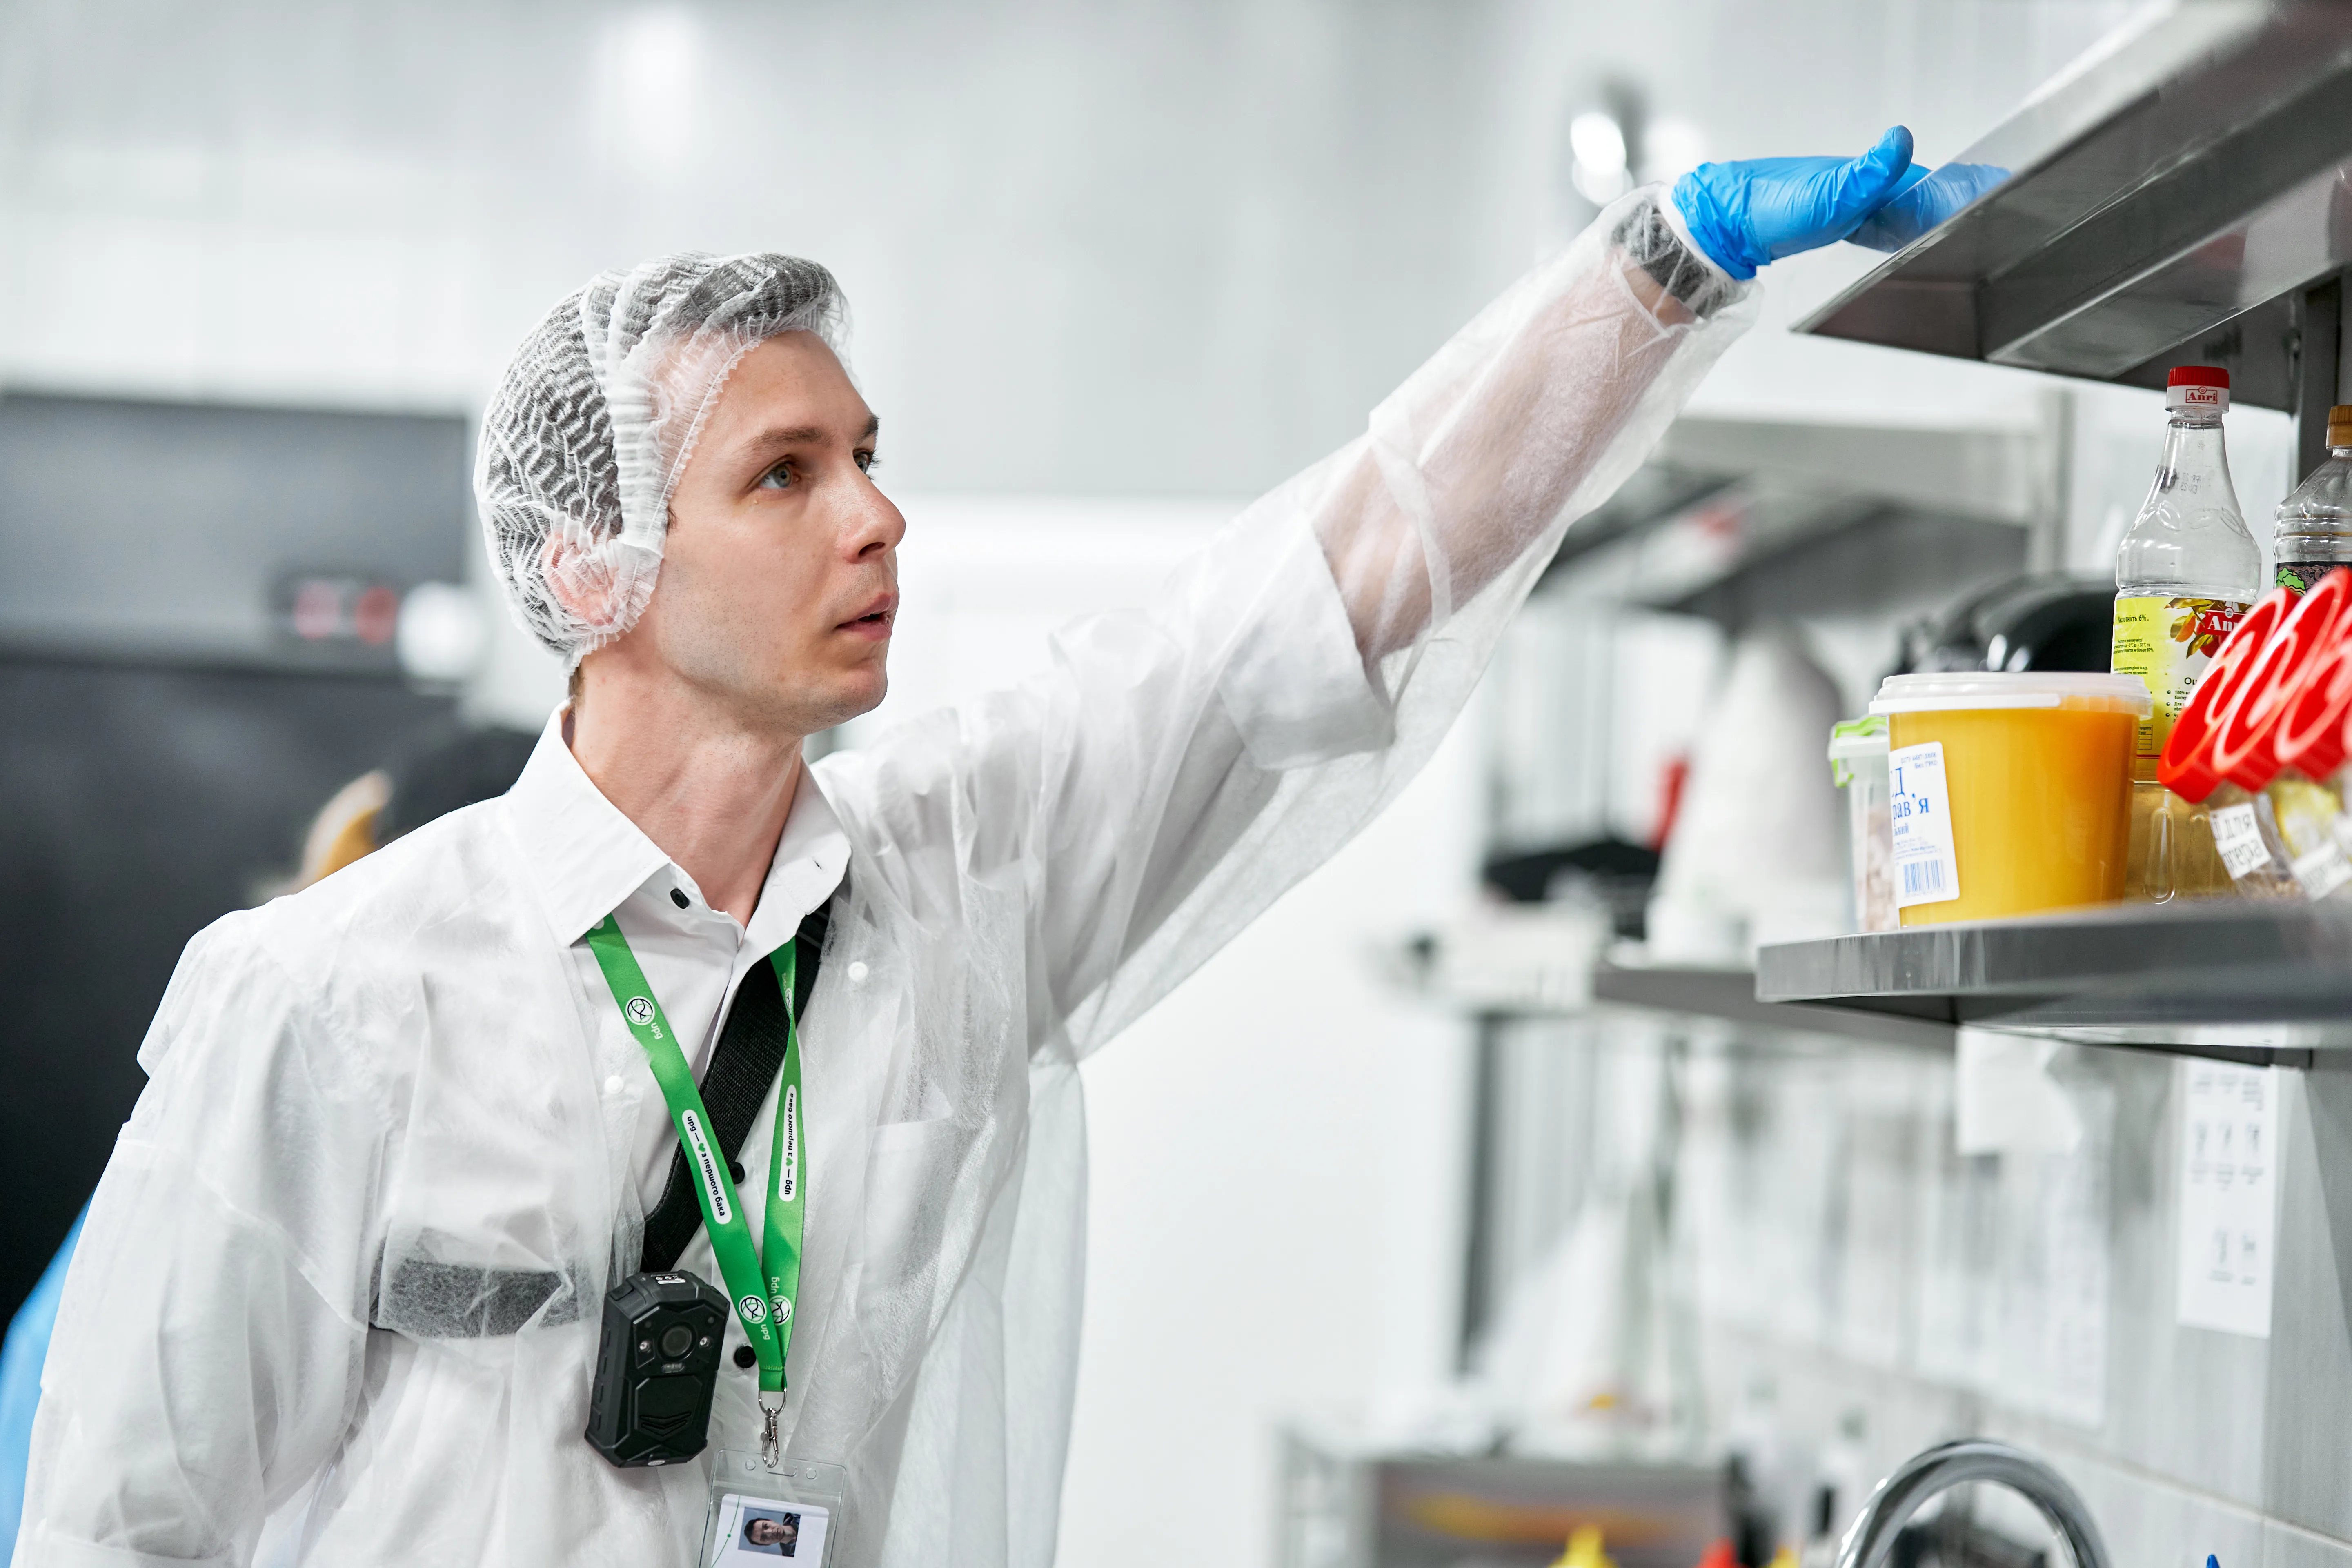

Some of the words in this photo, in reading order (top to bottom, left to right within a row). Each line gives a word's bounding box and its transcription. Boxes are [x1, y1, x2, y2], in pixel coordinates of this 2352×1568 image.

[2187, 392, 2216, 401] Anri
[651, 1022, 663, 1039] upg
[687, 1116, 696, 1132] upg
[704, 1159, 719, 1196] першого
[715, 1197, 725, 1217] бака
[771, 1277, 780, 1294] upg
[761, 1323, 771, 1341] upg
